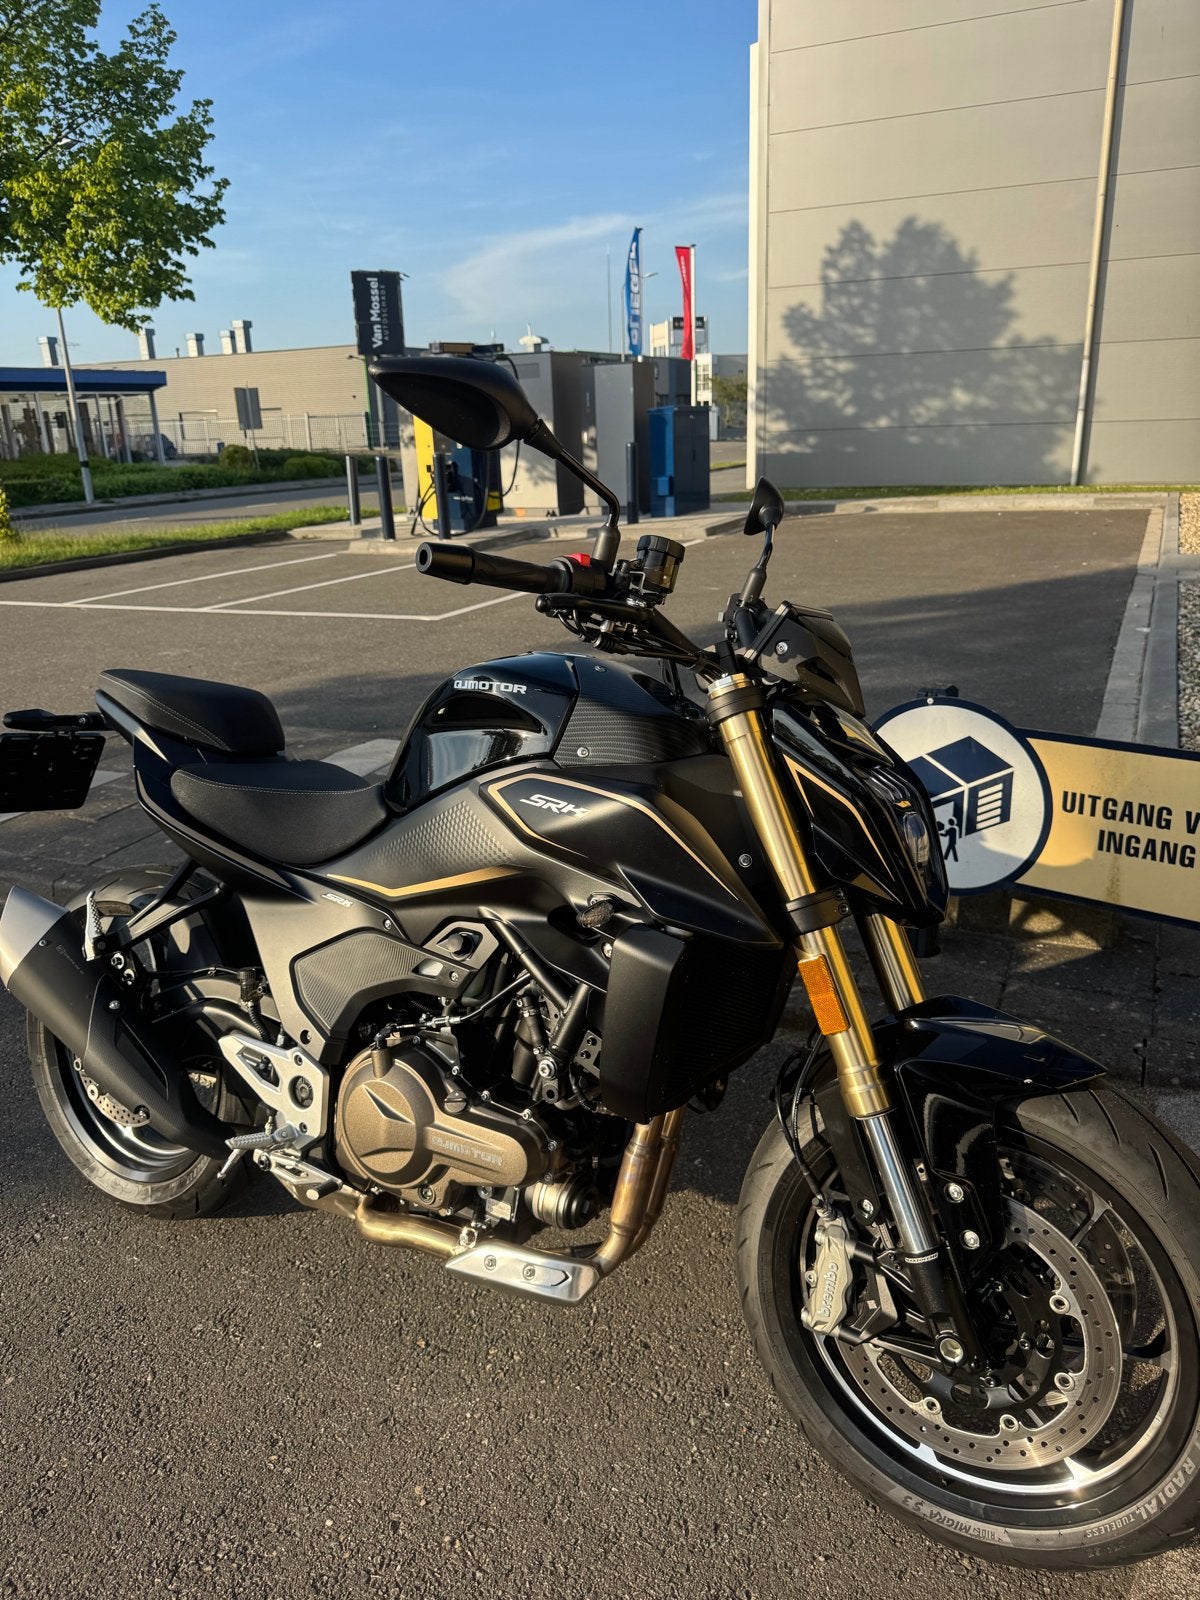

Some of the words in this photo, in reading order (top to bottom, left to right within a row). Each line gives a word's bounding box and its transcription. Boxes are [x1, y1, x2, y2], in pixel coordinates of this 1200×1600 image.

[366, 277, 381, 322] Mossel
[380, 284, 390, 341] AUTOSCHADE
[371, 324, 383, 348] Van
[453, 679, 527, 695] QJMOTOR
[519, 793, 592, 818] SRK
[1062, 790, 1173, 831] UITGANG
[1097, 829, 1196, 869] INGANG
[321, 893, 354, 908] SRK
[816, 1261, 839, 1318] brembo
[1136, 1457, 1196, 1519] RADIAL
[928, 1509, 972, 1534] MIGRA
[1086, 1513, 1136, 1538] TUBELESS
